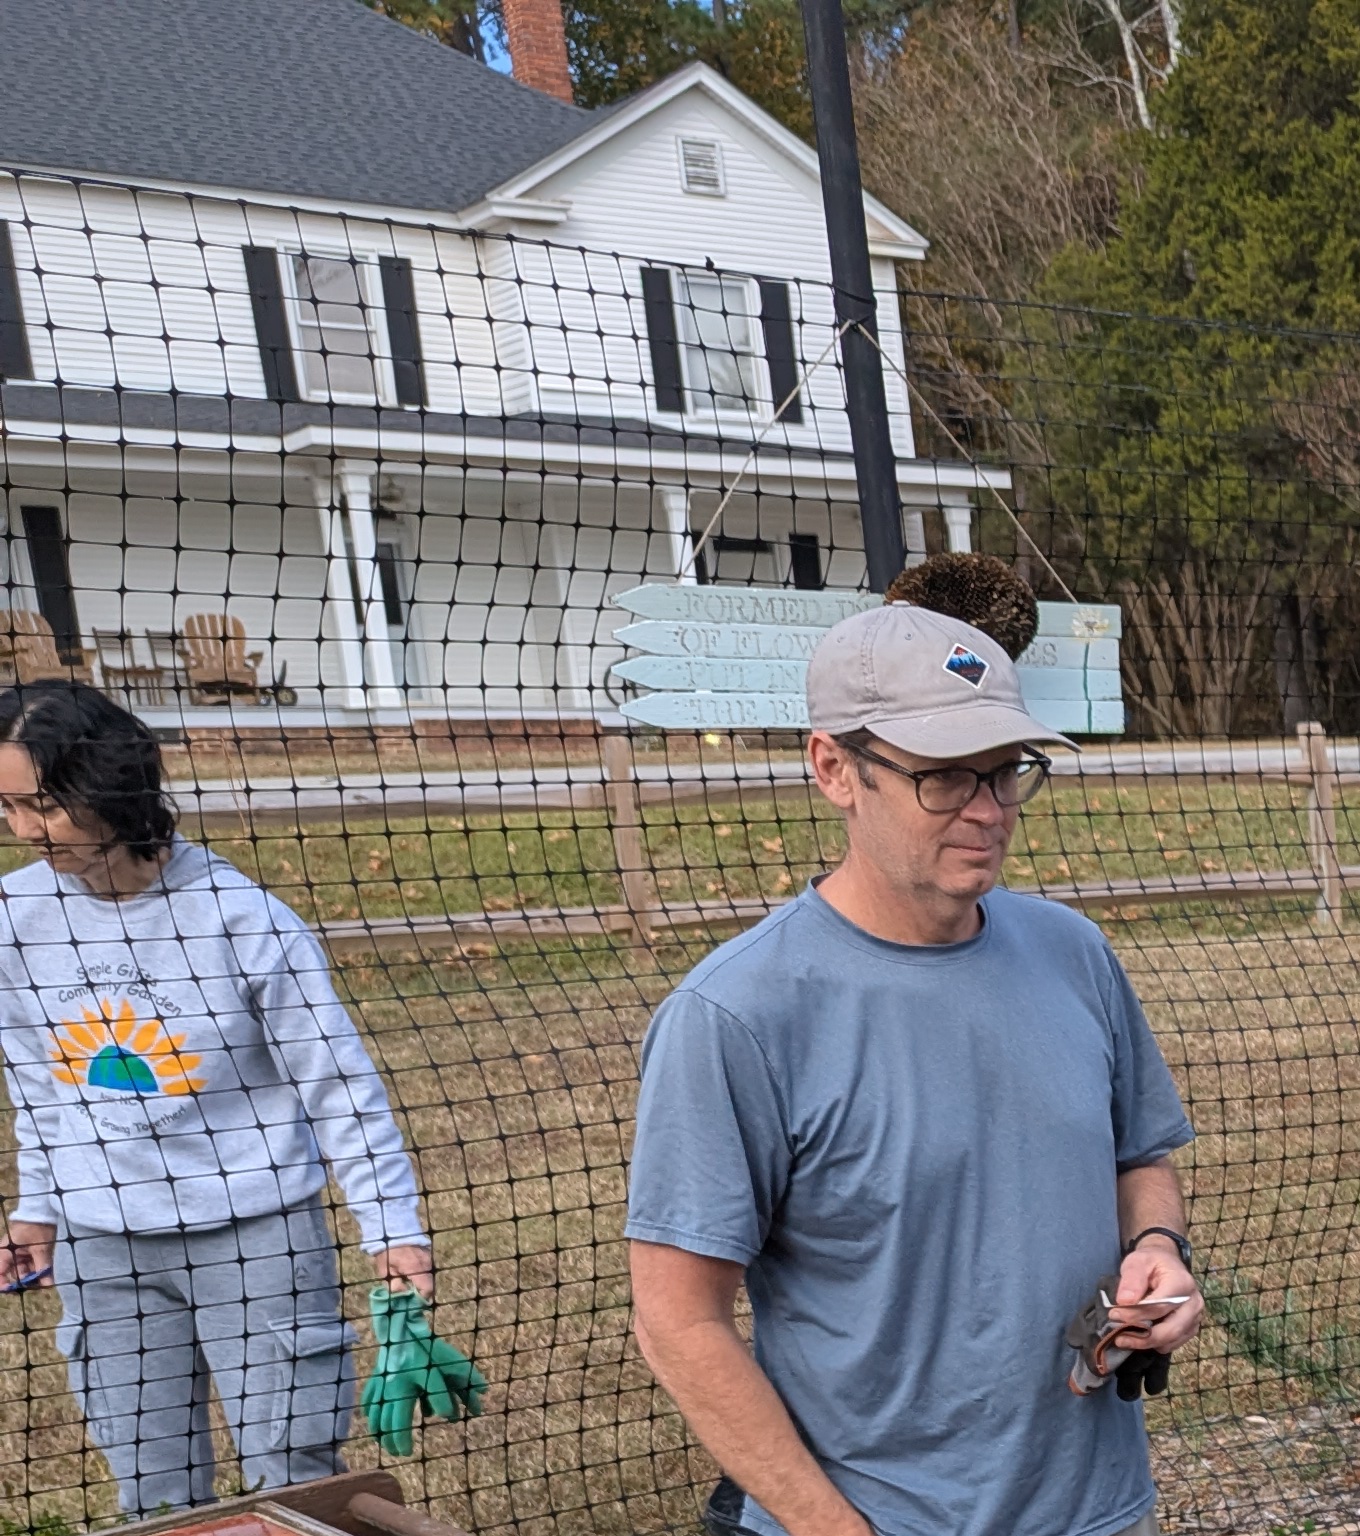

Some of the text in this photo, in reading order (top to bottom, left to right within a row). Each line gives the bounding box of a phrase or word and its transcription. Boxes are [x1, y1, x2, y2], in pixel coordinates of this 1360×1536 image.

[684, 592, 822, 624] FORMED
[680, 626, 721, 656] OF
[731, 630, 826, 659] FLOW
[690, 698, 810, 724] THE BE
[127, 983, 182, 1017] Garden
